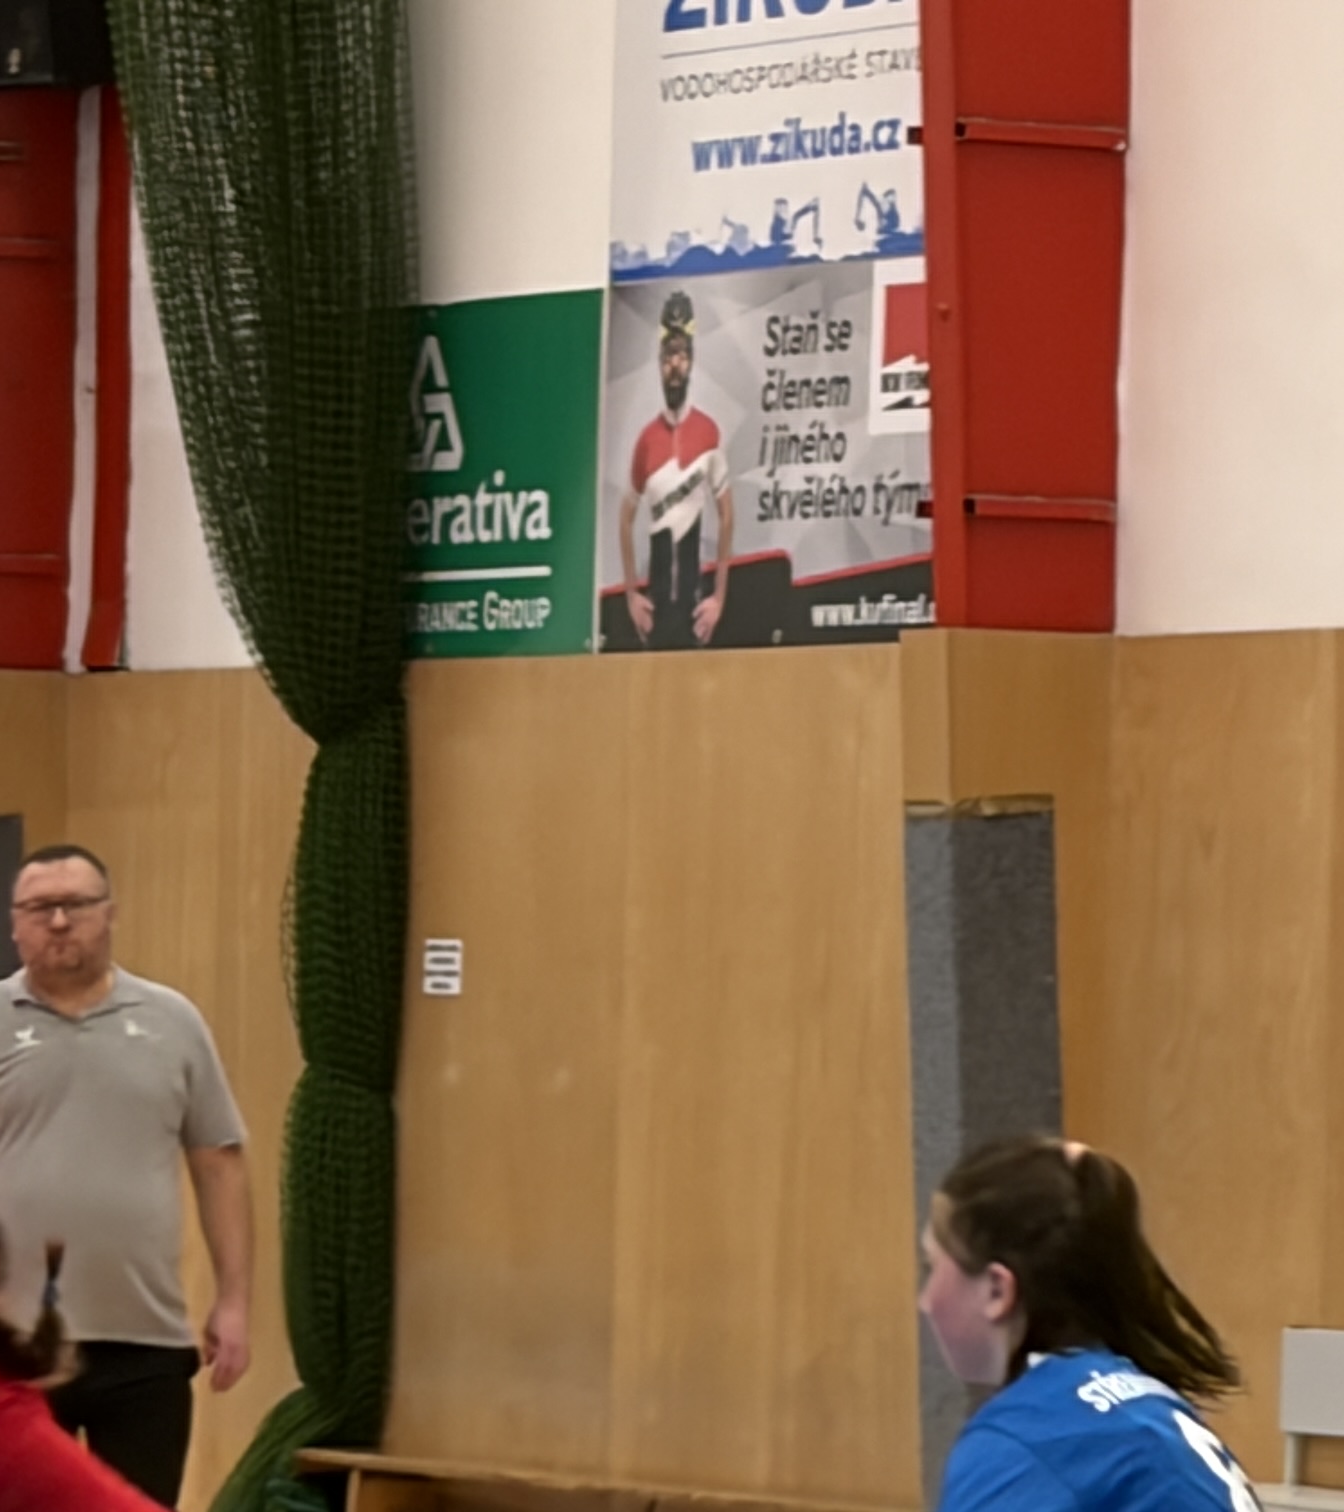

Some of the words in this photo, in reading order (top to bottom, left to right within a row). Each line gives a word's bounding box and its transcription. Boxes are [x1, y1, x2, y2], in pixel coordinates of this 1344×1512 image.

[691, 111, 902, 172] www.zikuda.cz
[763, 310, 820, 357] Staň
[824, 319, 853, 352] se
[761, 369, 851, 412] členem
[759, 425, 769, 466] i
[766, 420, 847, 478] jiného
[407, 469, 553, 545] erativa
[757, 474, 866, 522] skvělého
[873, 469, 932, 526] tým
[408, 600, 480, 632] RANCE
